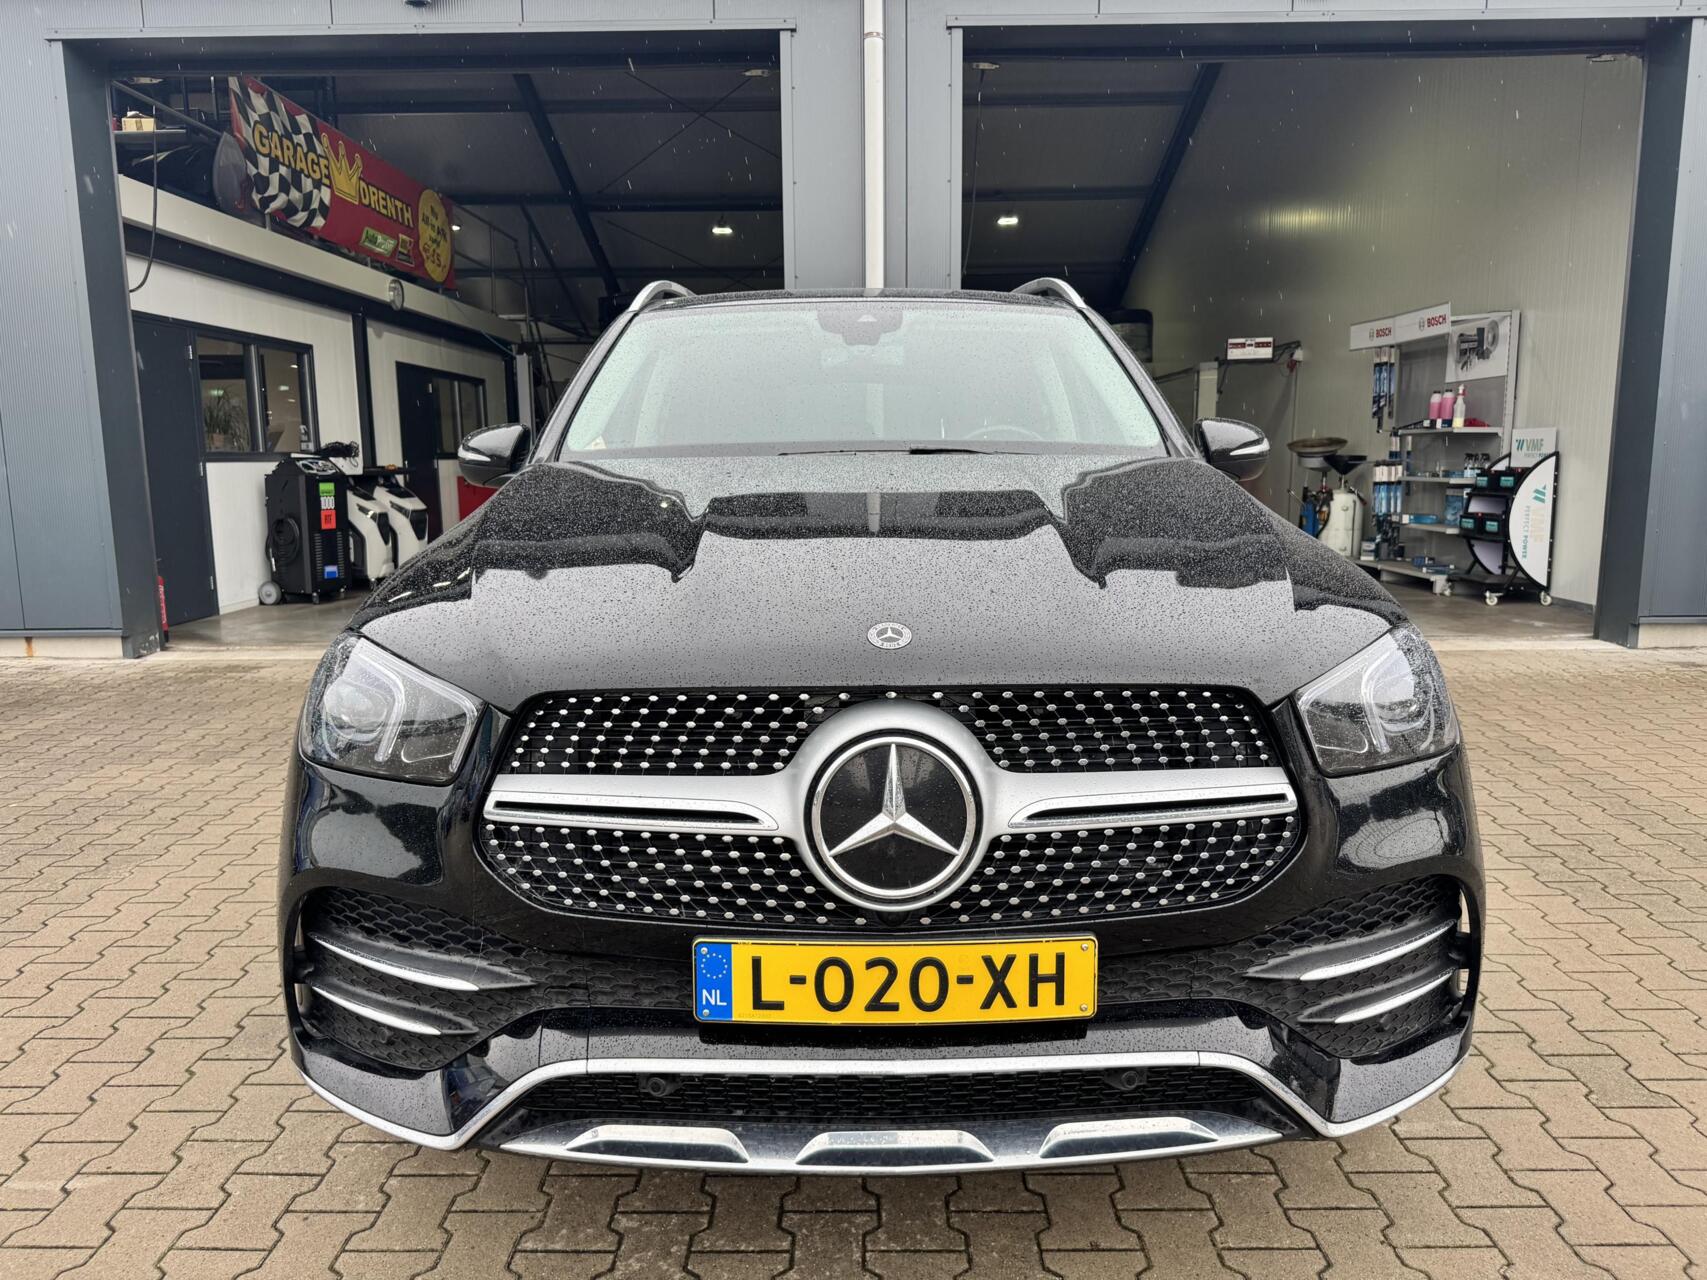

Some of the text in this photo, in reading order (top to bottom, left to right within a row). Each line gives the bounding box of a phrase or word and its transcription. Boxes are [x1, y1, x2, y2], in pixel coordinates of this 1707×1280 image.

[254, 121, 331, 185] GARAGE
[1426, 314, 1447, 328] BOSCH
[1375, 327, 1392, 338] BOSCH
[1526, 438, 1544, 451] VMF
[1521, 535, 1529, 559] POWER
[751, 952, 1065, 1012] L-020-XH
[702, 989, 727, 1005] NL
